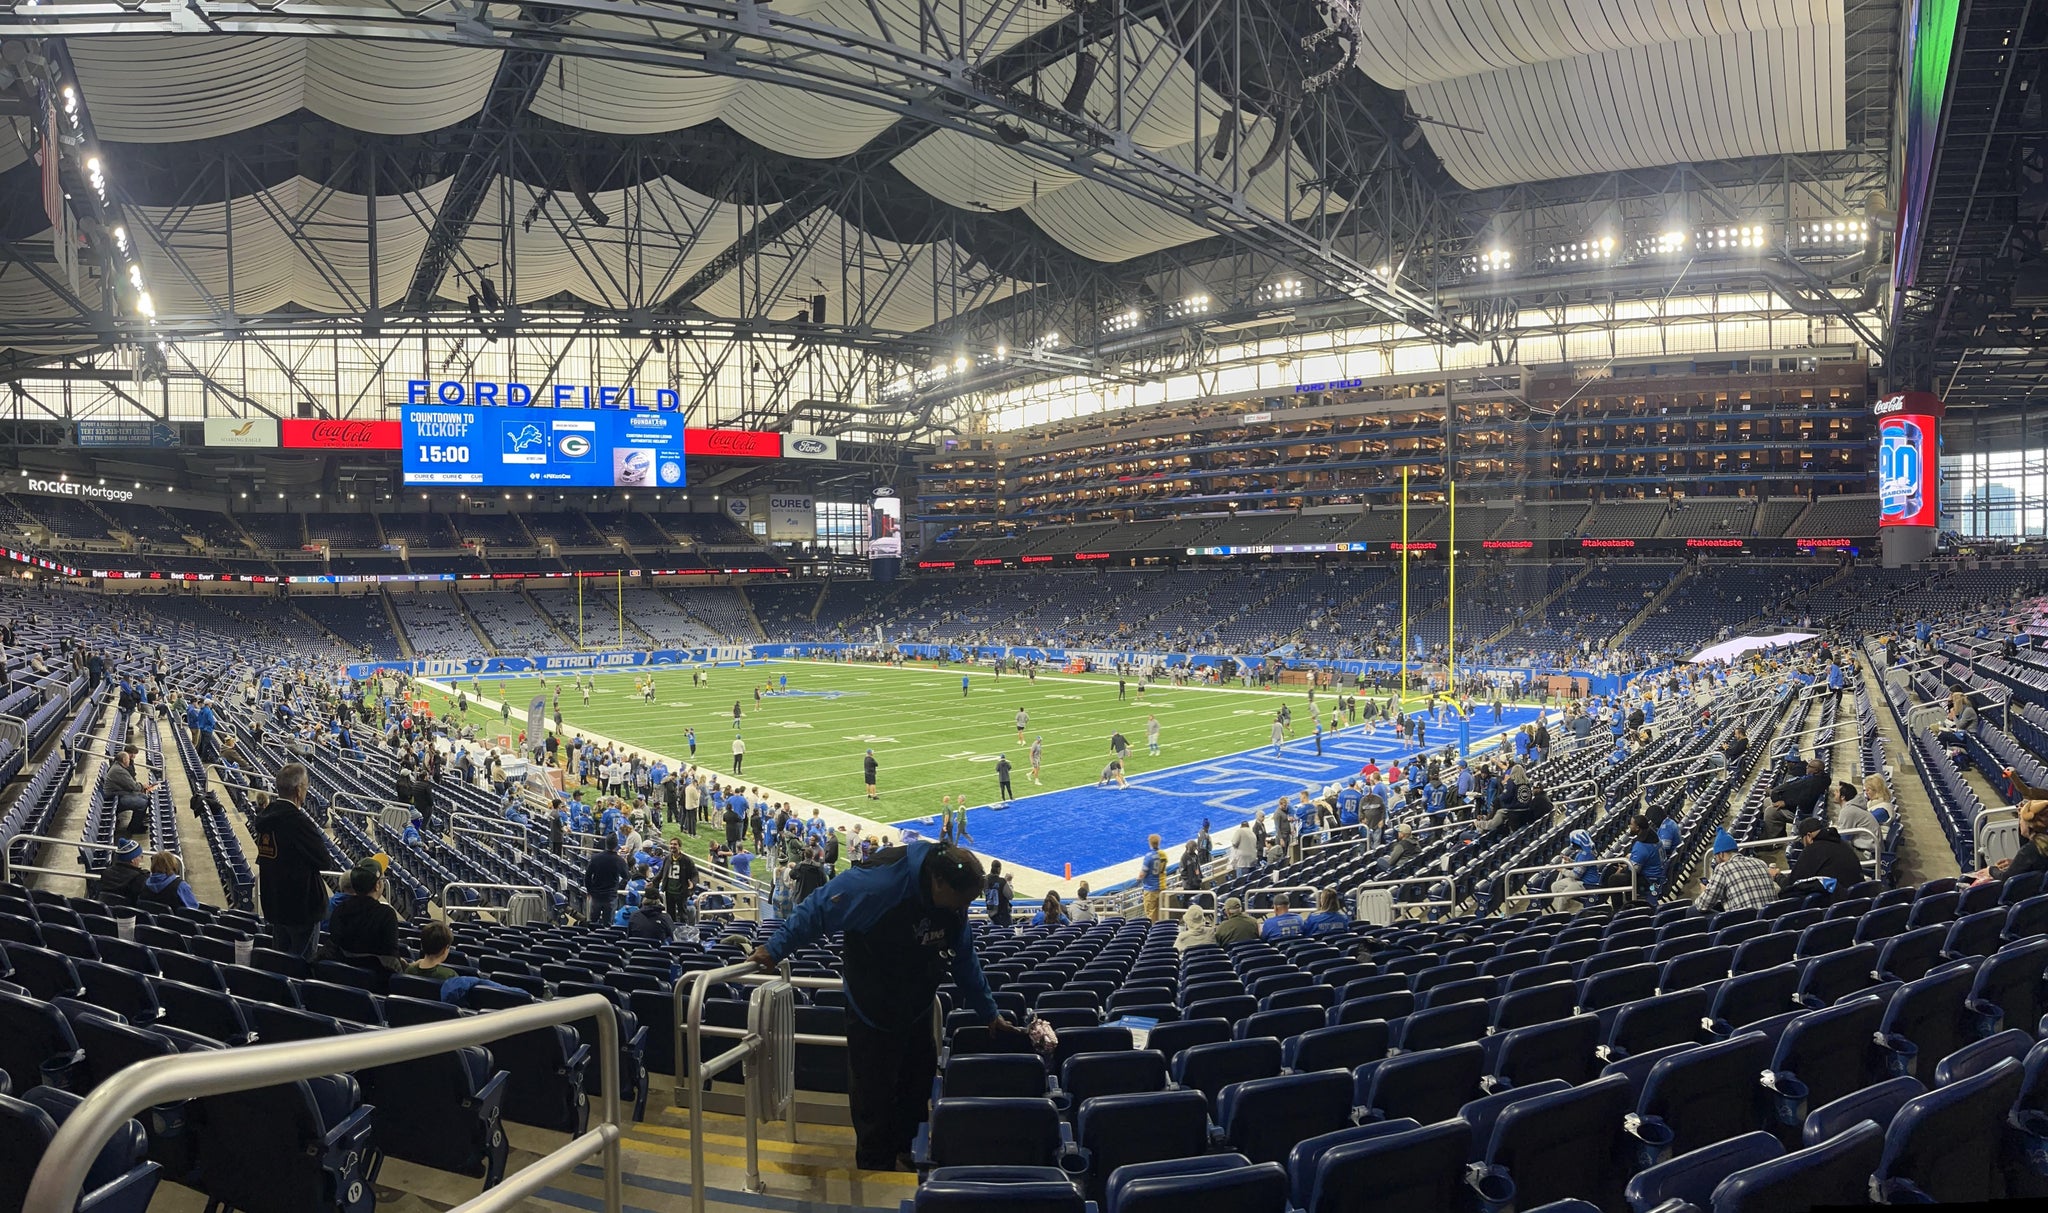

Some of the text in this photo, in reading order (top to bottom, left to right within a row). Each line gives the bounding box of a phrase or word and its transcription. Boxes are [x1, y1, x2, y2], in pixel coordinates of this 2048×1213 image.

[1296, 378, 1362, 393] FORD FIELD
[408, 379, 680, 412] FORD FIELD
[410, 412, 474, 423] COUNTDOWN TO
[417, 422, 468, 437] KICKOFF
[420, 445, 469, 462] 15:00
[799, 440, 822, 453] Ford
[1880, 444, 1918, 488] 90
[28, 478, 133, 501] ROCKET Mortgage
[771, 499, 802, 508] CURE
[1482, 540, 1533, 548] #takeataste
[1582, 539, 1635, 548] #takeataste
[1686, 538, 1743, 547] #takeataste
[1796, 538, 1850, 547] #takeataste
[108, 570, 123, 578] Coke
[124, 571, 141, 579] Ever?
[547, 653, 634, 668] DETROIT LIONS
[705, 645, 753, 662] LIONS
[412, 659, 469, 677] LIONS
[669, 864, 681, 880] 12
[350, 1184, 360, 1201] 19
